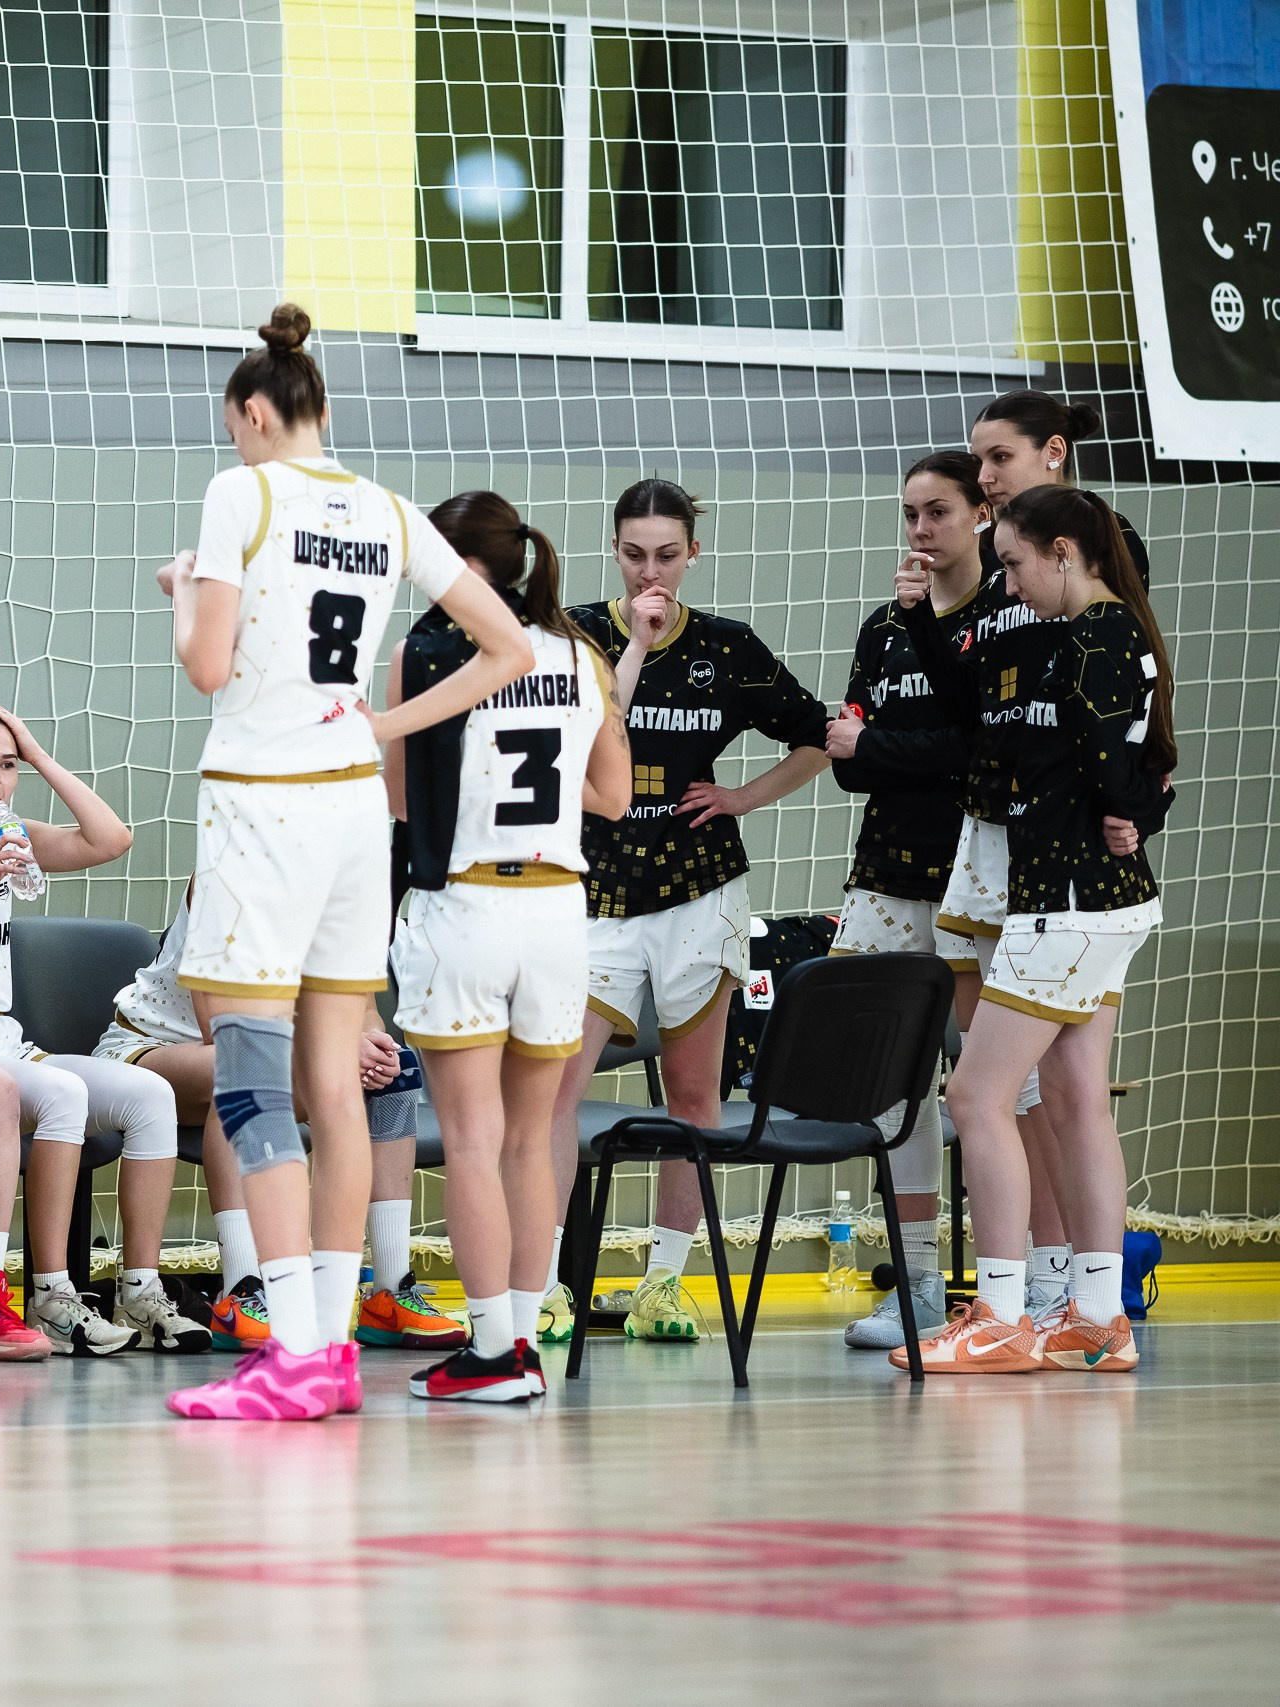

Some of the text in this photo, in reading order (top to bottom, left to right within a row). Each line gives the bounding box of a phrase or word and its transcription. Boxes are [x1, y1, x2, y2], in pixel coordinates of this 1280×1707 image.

[1230, 156, 1247, 181] г.
[1243, 222, 1271, 252] +7
[293, 530, 389, 577] ШЕВЧЕНКО
[308, 588, 367, 686] 8
[692, 668, 712, 679] РФБ
[494, 727, 562, 827] 3
